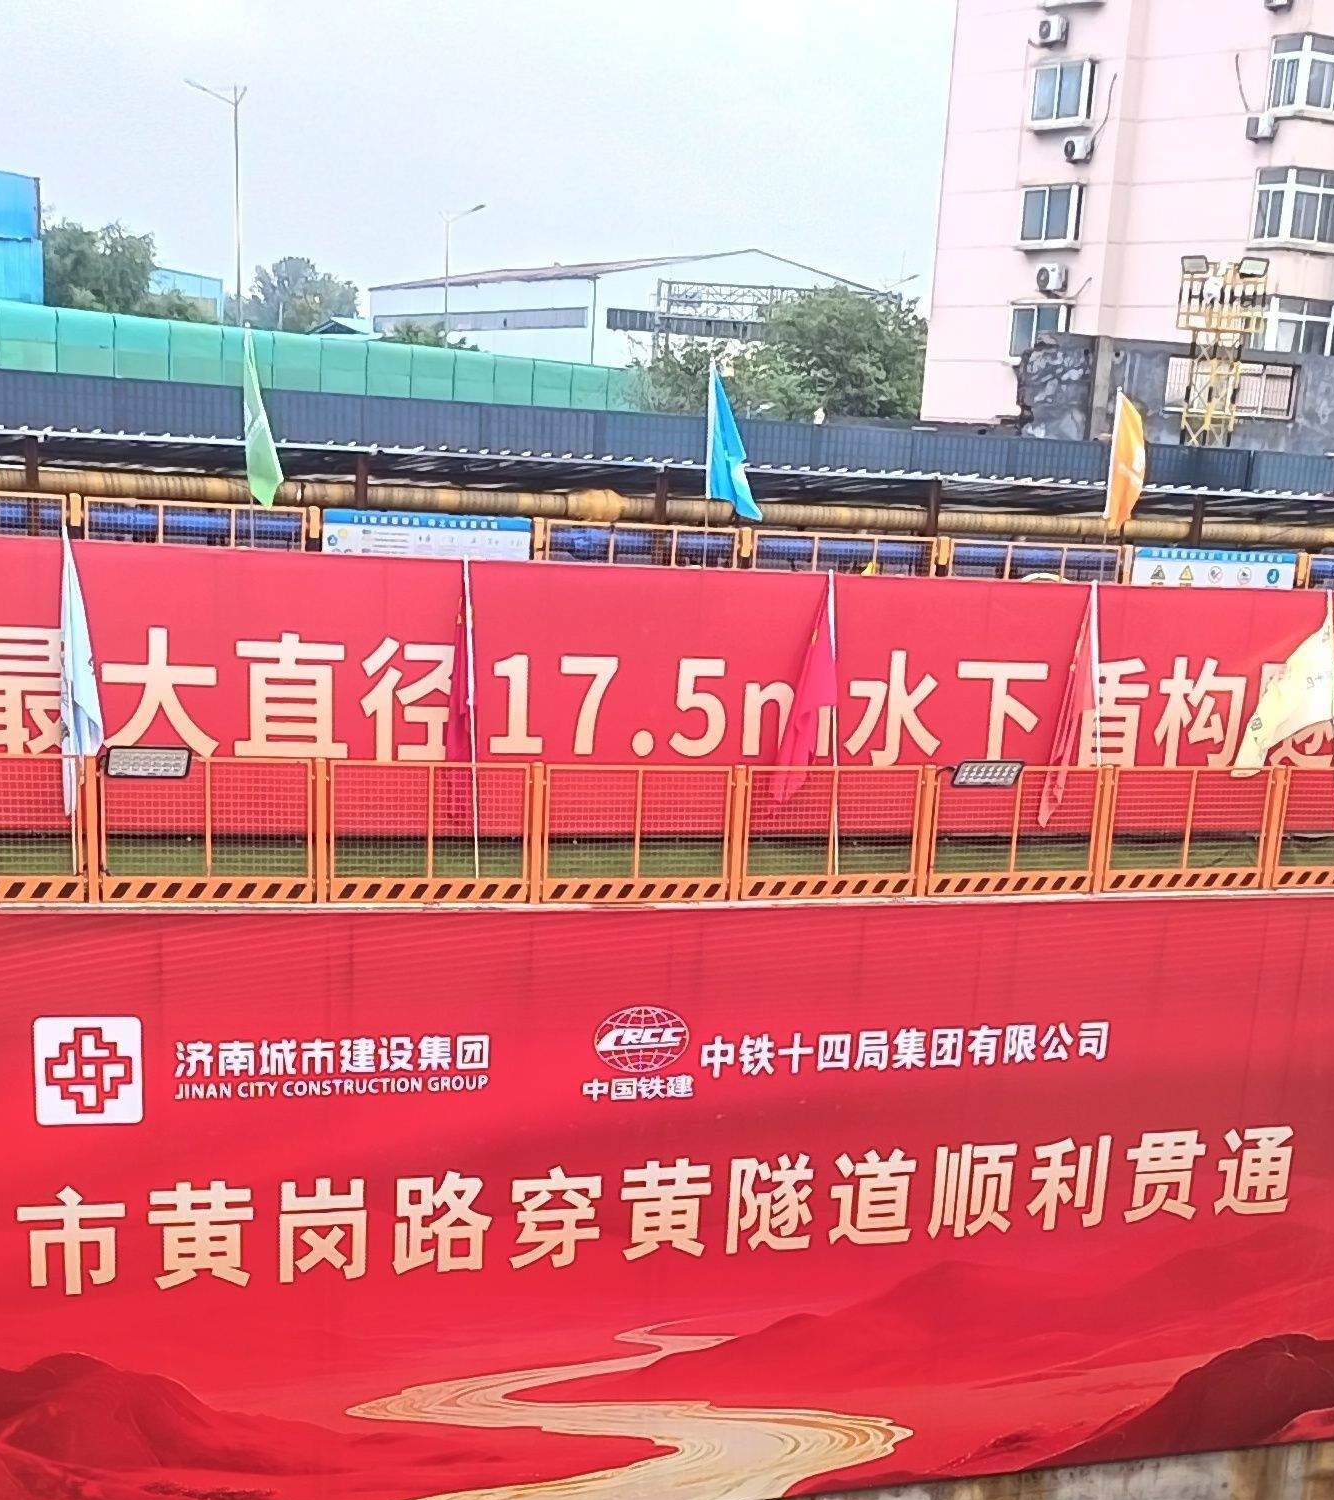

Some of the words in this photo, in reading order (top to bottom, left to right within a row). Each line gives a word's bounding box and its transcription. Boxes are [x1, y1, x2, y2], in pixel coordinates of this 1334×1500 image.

[175, 1033, 492, 1079] 济南城市建设集团
[699, 1020, 1111, 1079] 中铁十四局集团有限公司
[175, 1080, 233, 1101] JINAN
[236, 1078, 279, 1099] CITY
[281, 1076, 424, 1098] CONSTRUCTION
[427, 1074, 491, 1095] GROUP
[581, 1073, 695, 1102] 中国铁建
